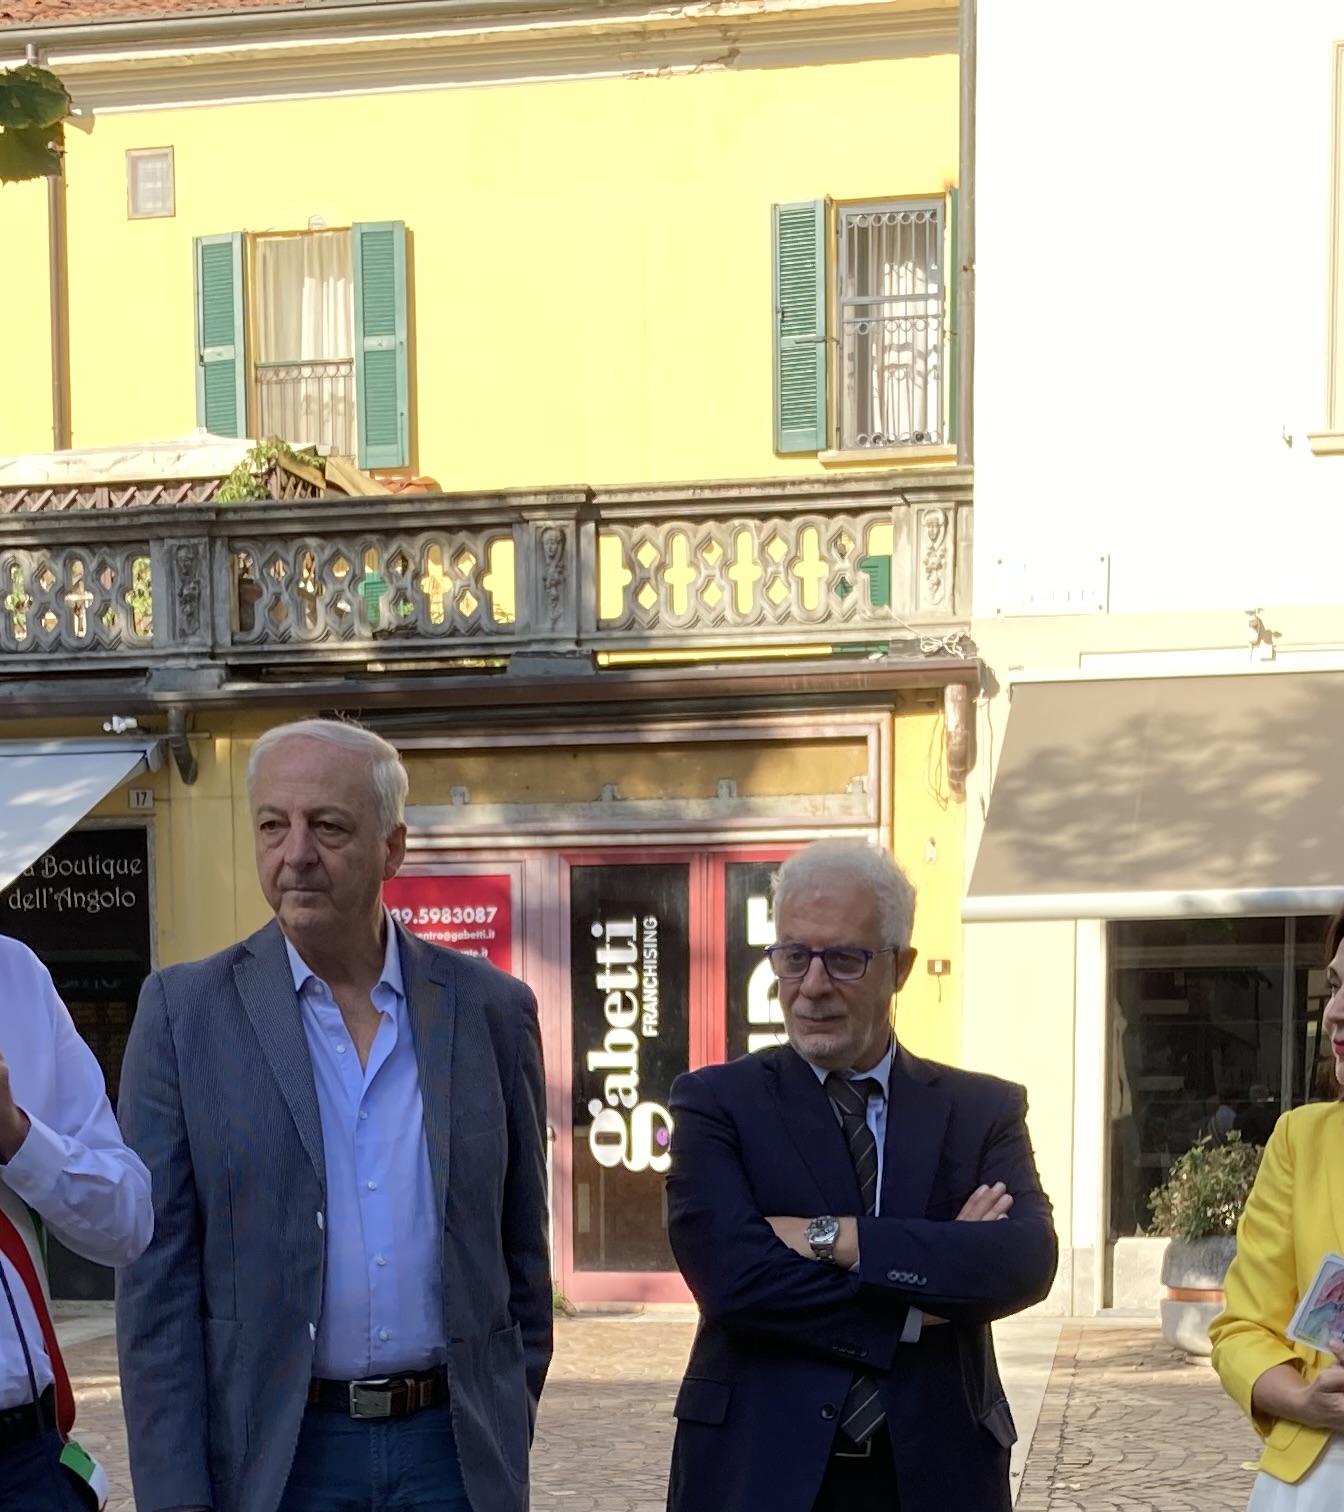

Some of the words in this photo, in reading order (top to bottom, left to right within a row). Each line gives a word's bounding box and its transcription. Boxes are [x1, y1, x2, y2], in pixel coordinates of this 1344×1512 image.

[135, 791, 148, 806] 17
[41, 854, 143, 880] Boutique
[8, 886, 136, 914] dell'Angolo
[390, 906, 498, 925] 39.5983087
[415, 929, 496, 942] entro@gabetti.it
[642, 915, 658, 1038] FRANCHISING
[587, 916, 673, 1173] gabetti
